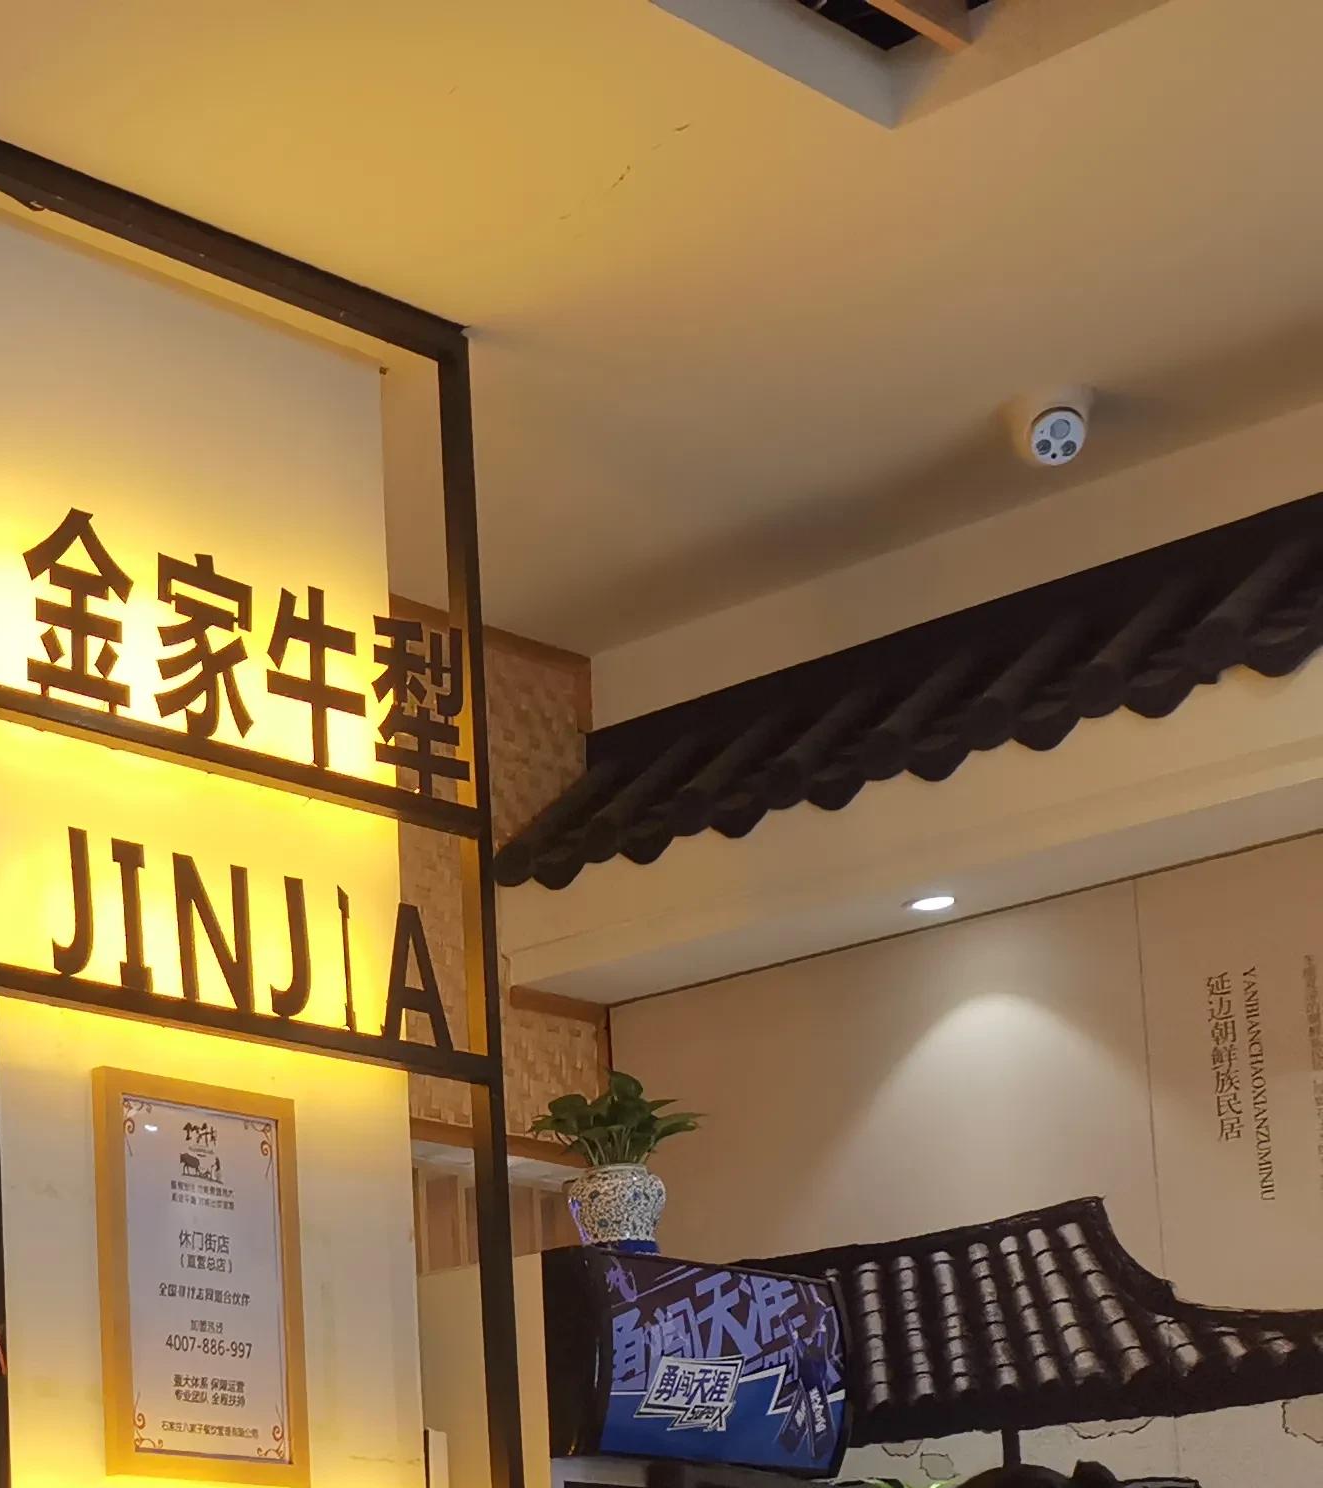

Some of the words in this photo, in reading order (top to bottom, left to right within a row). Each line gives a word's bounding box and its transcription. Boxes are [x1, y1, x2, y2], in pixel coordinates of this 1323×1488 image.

[23, 508, 471, 798] 金家牛犁
[51, 826, 454, 1052] JINJIA
[1206, 971, 1244, 1142] 延边朝鲜族民居
[179, 1229, 231, 1255] 休门街店
[165, 1334, 253, 1360] 4007-886-997
[654, 1364, 733, 1406] 勇闯天涯
